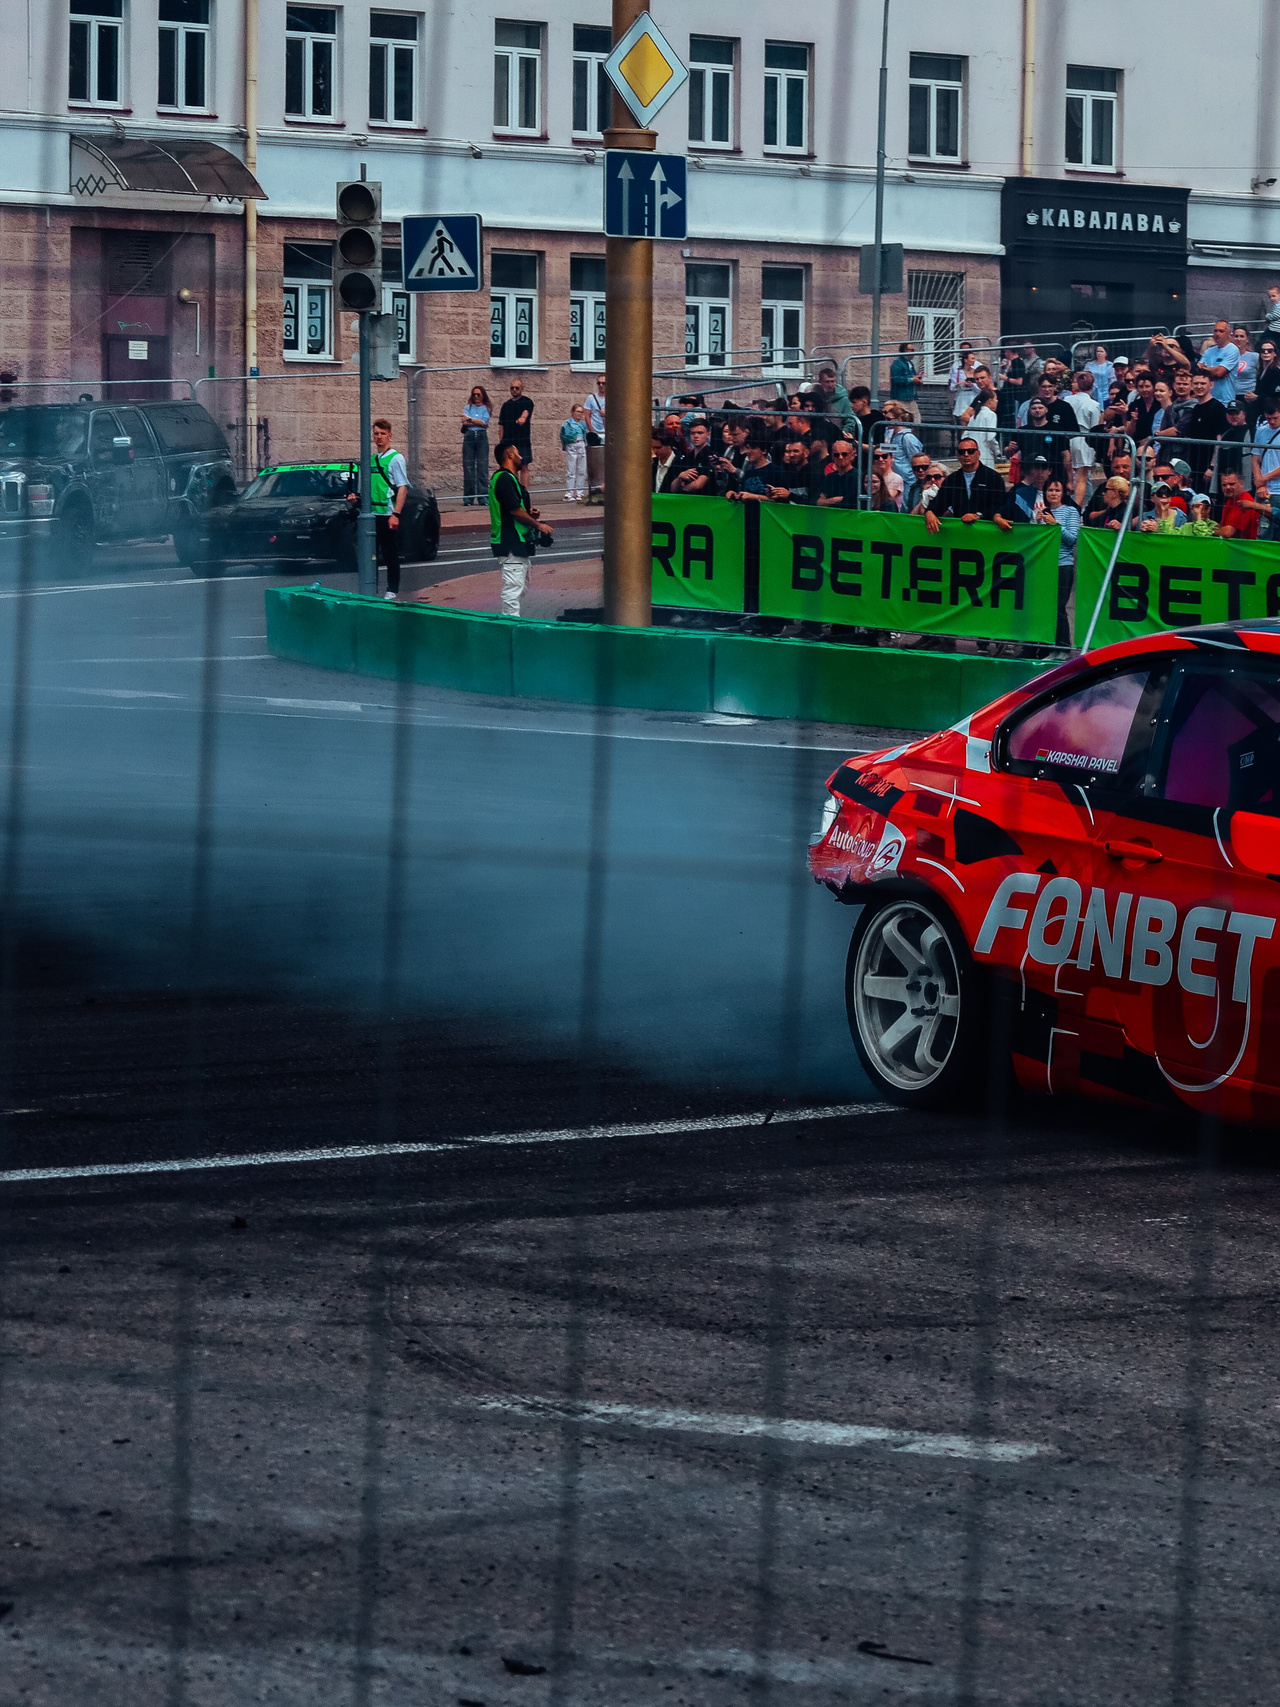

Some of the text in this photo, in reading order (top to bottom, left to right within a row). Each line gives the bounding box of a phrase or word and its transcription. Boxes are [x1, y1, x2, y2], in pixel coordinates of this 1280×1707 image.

[1042, 208, 1164, 233] КАВАЛАВА
[1047, 750, 1118, 772] KAPSHAI PAVEL
[974, 873, 1276, 1003] FONBET
